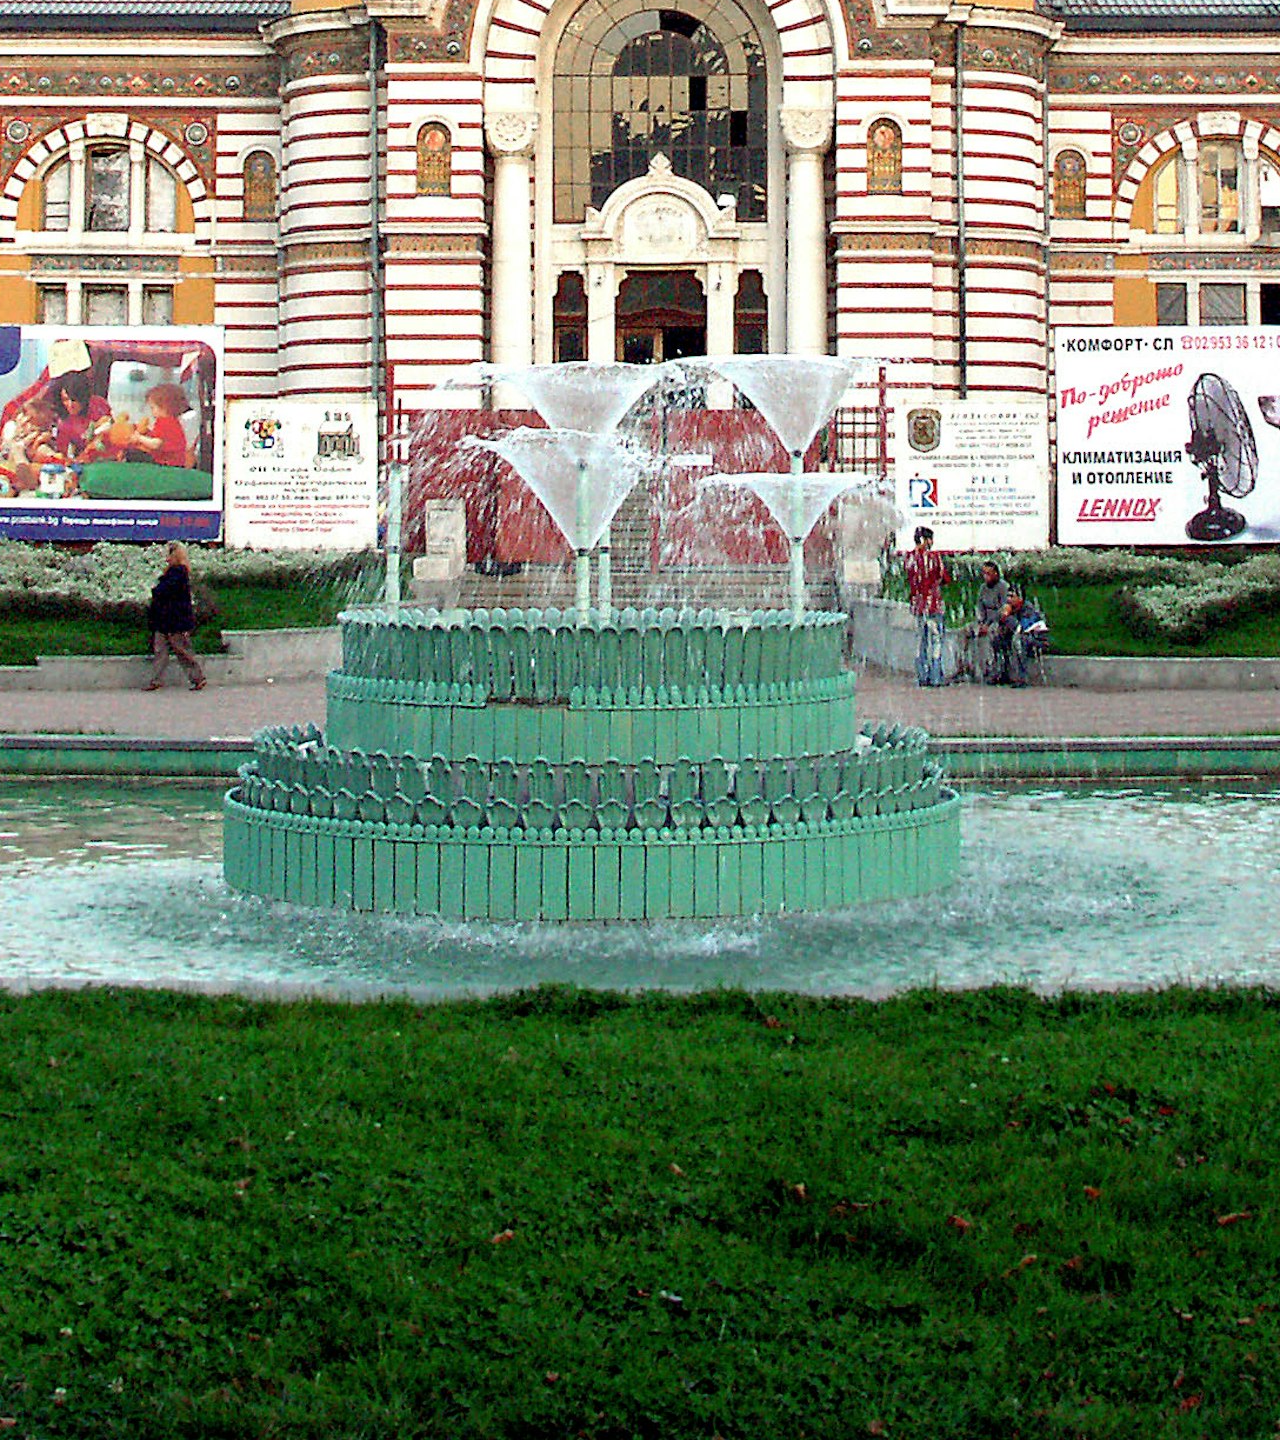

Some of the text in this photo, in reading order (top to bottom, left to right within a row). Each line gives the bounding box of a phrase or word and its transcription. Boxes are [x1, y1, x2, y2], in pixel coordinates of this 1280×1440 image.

[1061, 363, 1183, 408] По-доброто
[1087, 394, 1170, 439] решение
[1062, 450, 1182, 464] КЛИМАТИЗАЦИЯ
[1072, 472, 1173, 484] И ОТОПЛЕНИЕ
[1078, 498, 1161, 517] LENNOX
